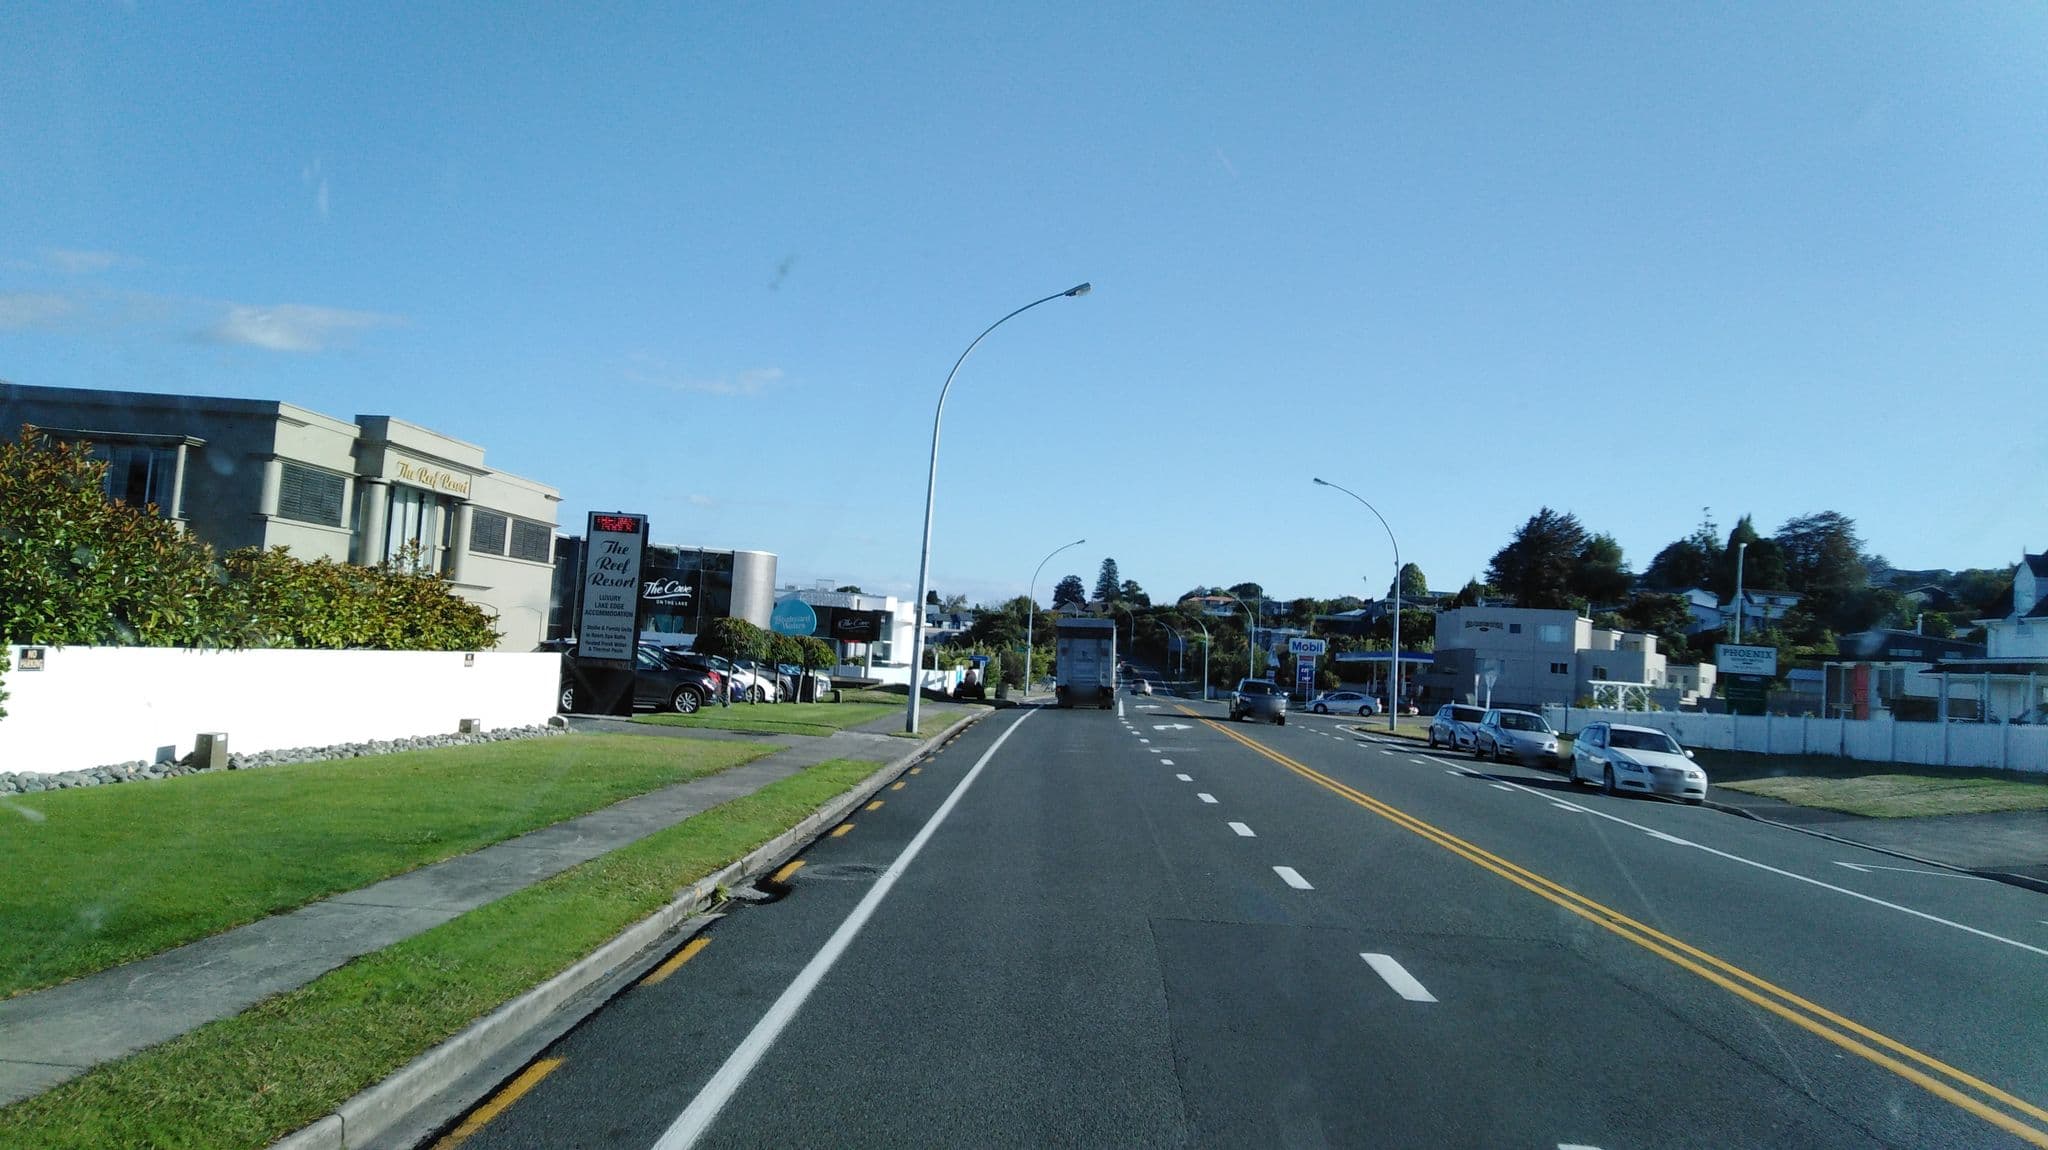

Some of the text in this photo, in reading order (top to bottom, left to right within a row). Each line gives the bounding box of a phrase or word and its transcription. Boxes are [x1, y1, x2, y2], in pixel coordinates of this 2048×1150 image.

[397, 460, 469, 494] The Reef Resort
[600, 540, 630, 555] The
[596, 556, 631, 575] Reef
[588, 572, 636, 588] Resort
[643, 578, 692, 598] The Cove
[1291, 640, 1323, 652] Mobil
[1722, 648, 1773, 659] PHOENIX
